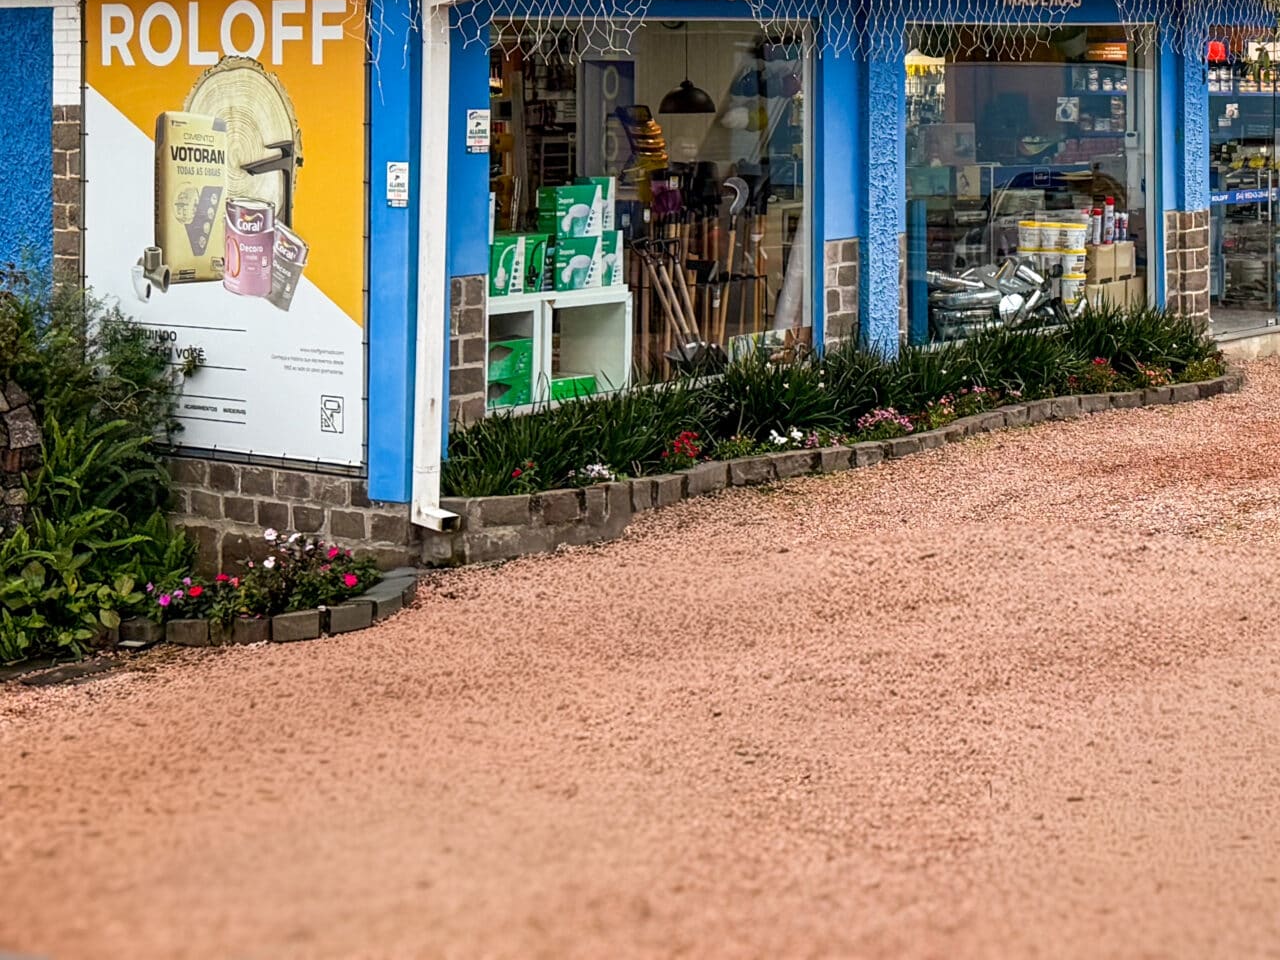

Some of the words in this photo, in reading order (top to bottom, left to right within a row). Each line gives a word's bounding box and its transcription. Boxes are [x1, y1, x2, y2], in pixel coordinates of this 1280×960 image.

[170, 145, 225, 165] VOTORAN
[237, 219, 260, 232] Coral
[275, 240, 296, 260] Coral
